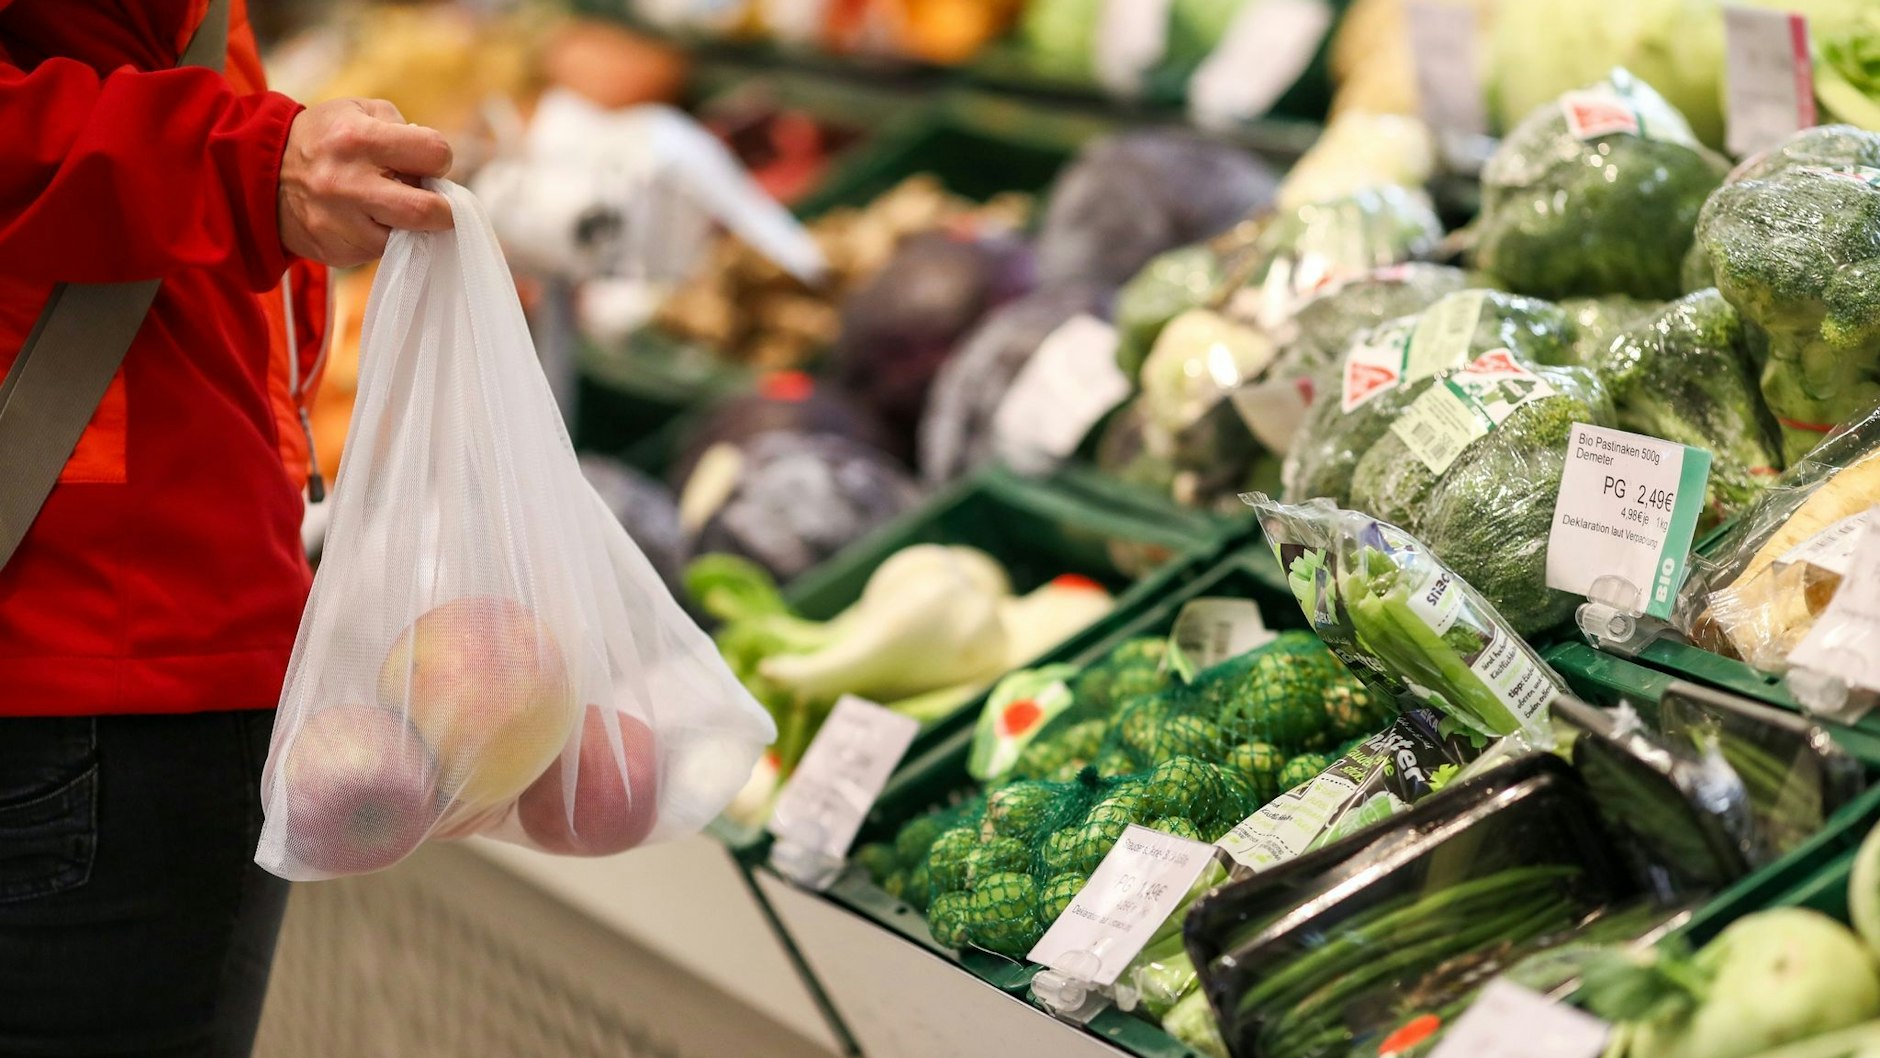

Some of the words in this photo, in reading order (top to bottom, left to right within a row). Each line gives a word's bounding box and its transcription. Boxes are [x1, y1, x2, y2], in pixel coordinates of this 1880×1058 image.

[1576, 448, 1614, 466] Demeter
[1578, 433, 1594, 446] Bio
[1596, 437, 1640, 458] Pastinaken
[1641, 448, 1660, 466] 500g
[1604, 476, 1626, 498] PG
[1637, 484, 1674, 512] 2,49€
[1562, 514, 1610, 534] Deklaration
[1611, 525, 1624, 539] laut
[1656, 558, 1675, 602] BIO
[1508, 680, 1524, 698] tipp:
